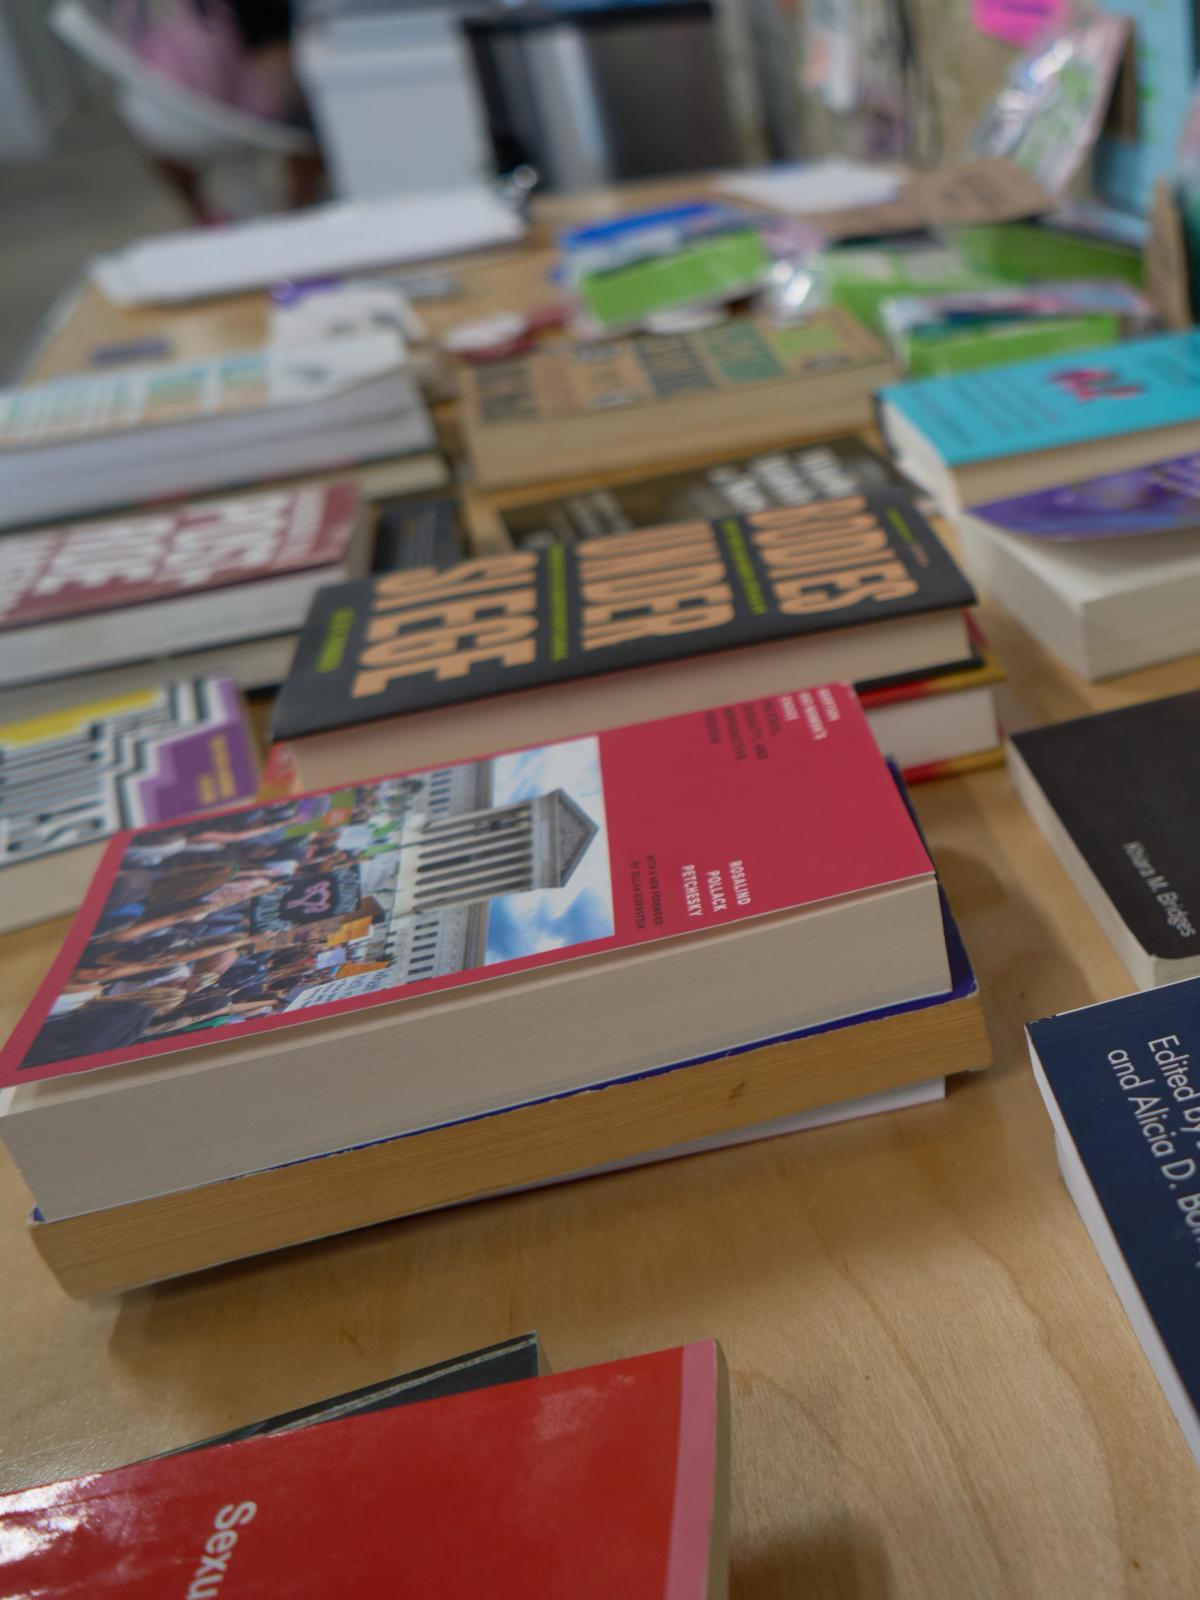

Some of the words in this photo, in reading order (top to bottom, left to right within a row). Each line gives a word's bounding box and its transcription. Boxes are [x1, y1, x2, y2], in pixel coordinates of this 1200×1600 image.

[576, 520, 735, 651] UNDER
[747, 496, 918, 615] BODIES
[352, 553, 539, 698] SIEGE
[681, 863, 703, 917] PETCHESKY
[706, 869, 728, 913] POLLACK
[728, 859, 752, 906] ROSALIND
[1156, 891, 1197, 938] Bridges
[1107, 1048, 1147, 1092] and
[1127, 1095, 1176, 1158] Alicia
[1161, 1157, 1196, 1189] D.
